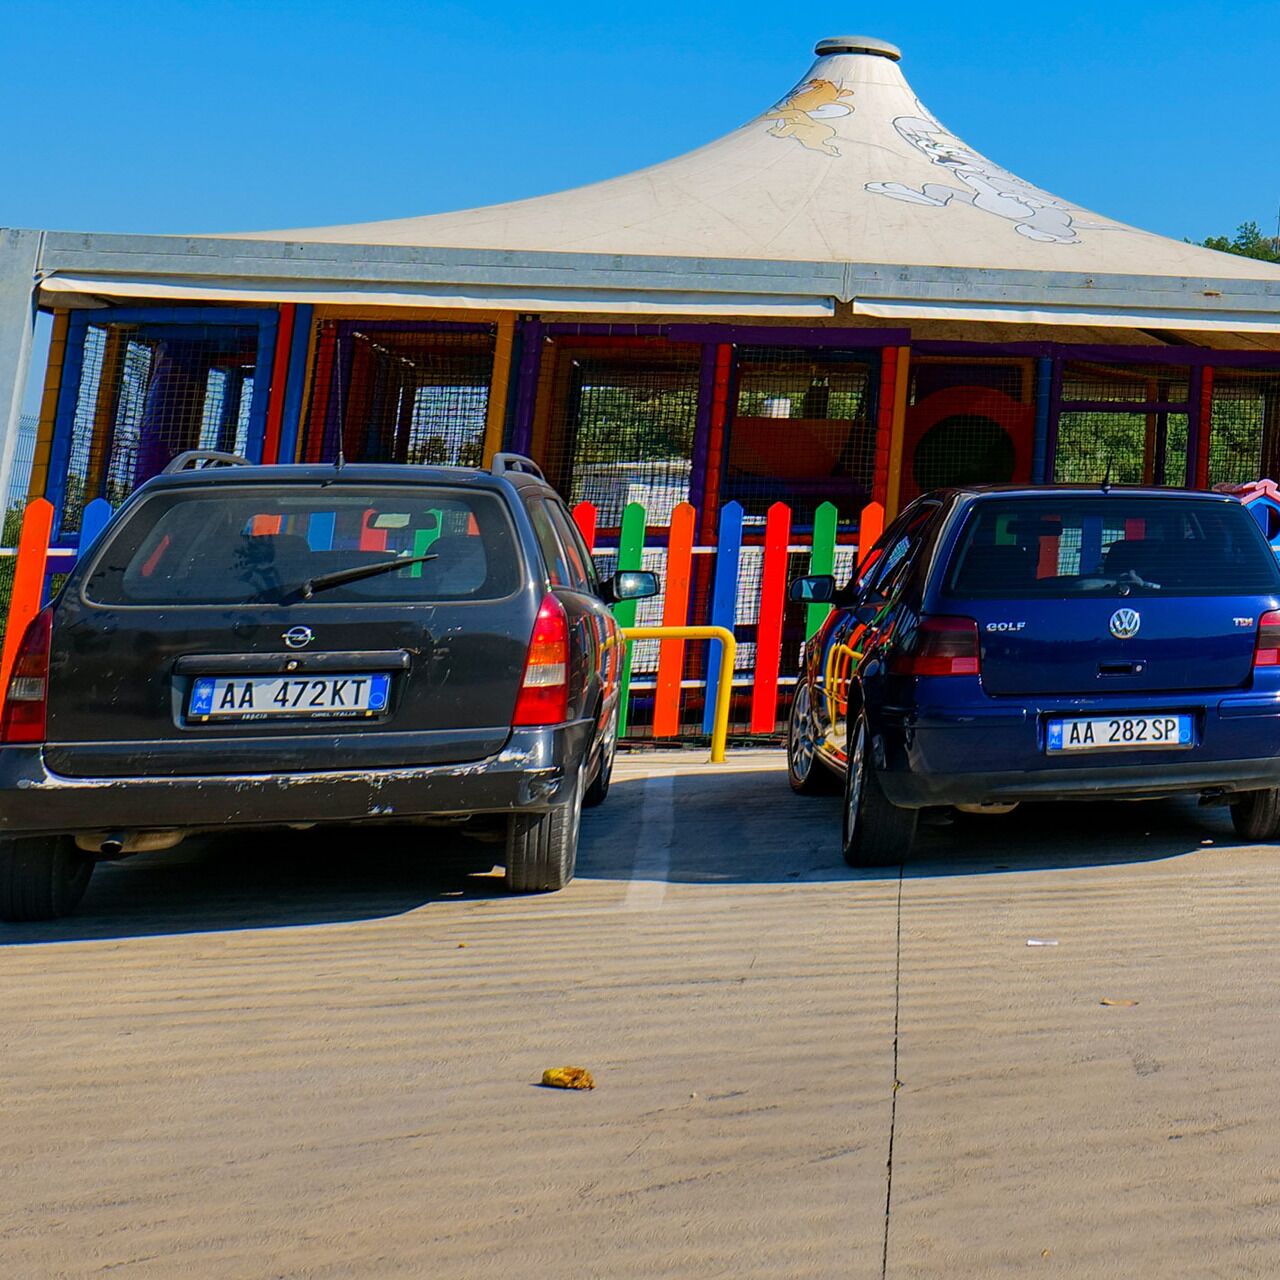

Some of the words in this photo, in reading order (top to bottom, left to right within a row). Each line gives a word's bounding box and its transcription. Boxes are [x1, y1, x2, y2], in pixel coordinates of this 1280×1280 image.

[986, 621, 1026, 632] GOLF
[219, 681, 255, 709] AA
[273, 679, 367, 708] 472KT
[195, 701, 209, 709] AL
[1069, 721, 1095, 744] AA
[1108, 719, 1176, 743] 282SP
